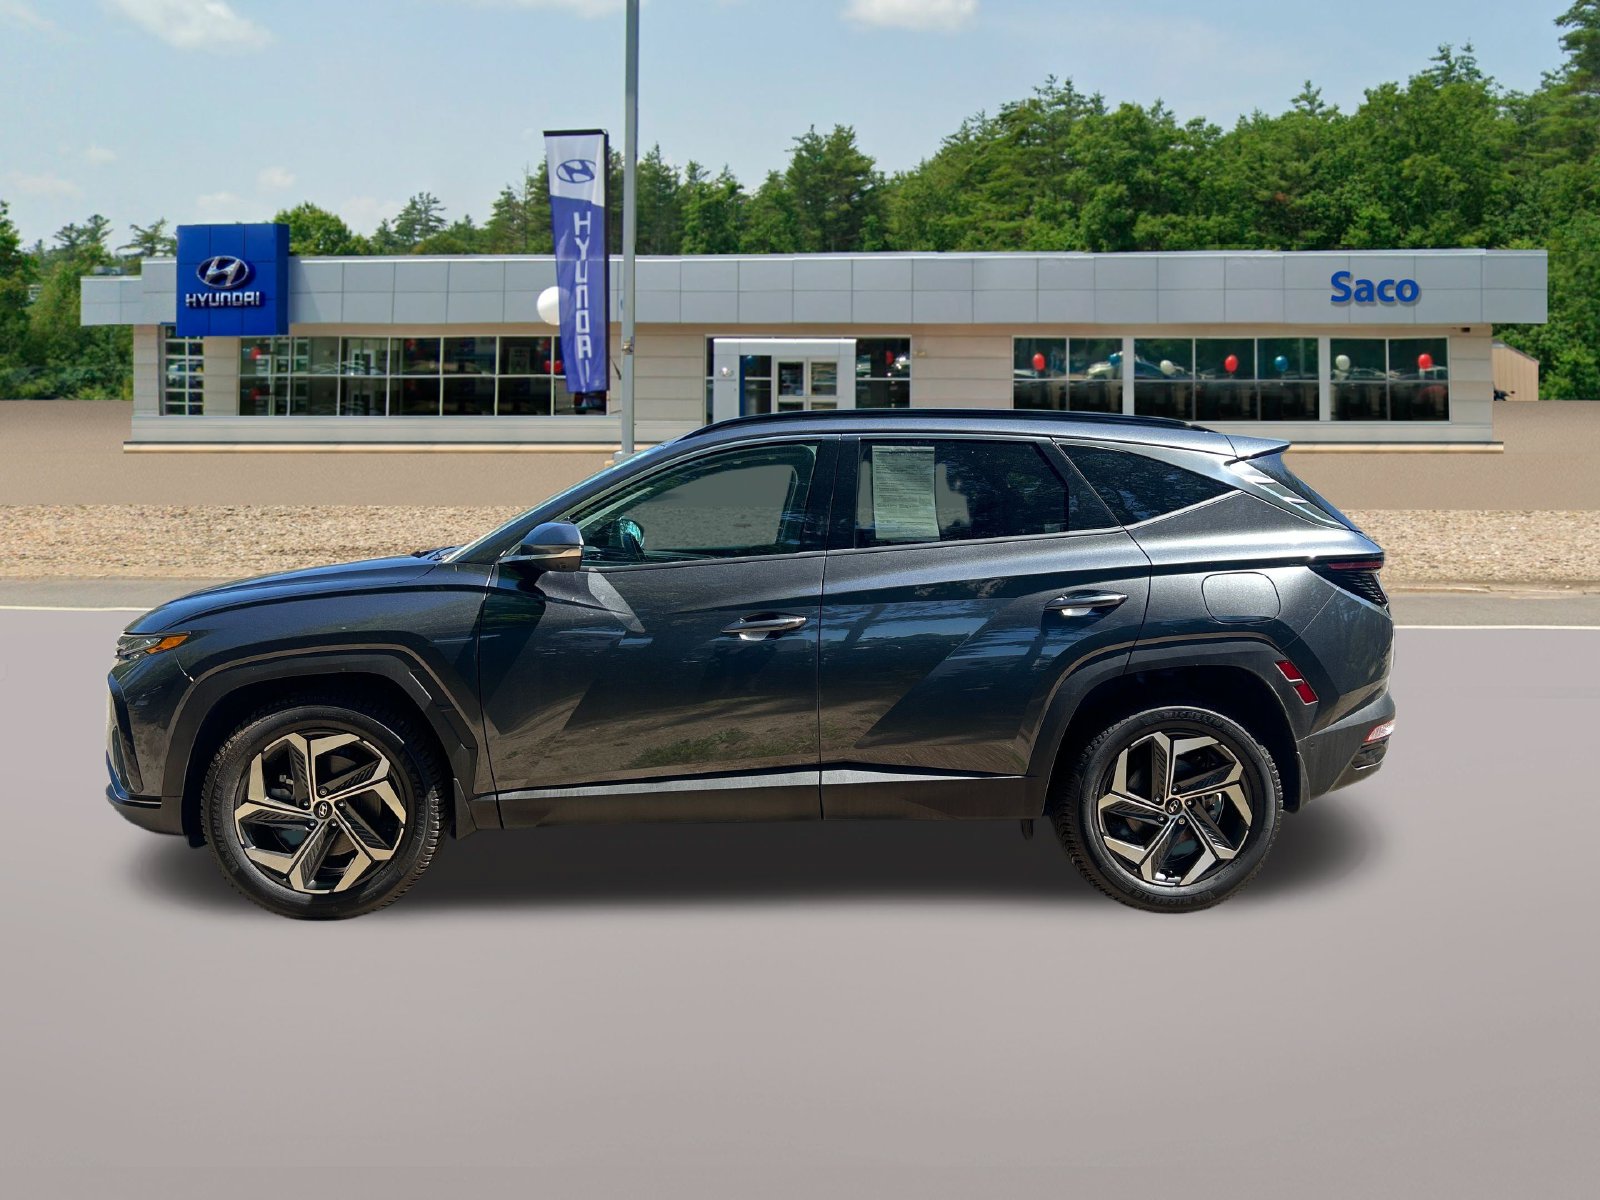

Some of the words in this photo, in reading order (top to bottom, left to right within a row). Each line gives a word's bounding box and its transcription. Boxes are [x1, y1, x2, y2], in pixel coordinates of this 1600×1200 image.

[185, 291, 260, 307] HYUNDAI
[573, 210, 592, 384] HYUNDAI
[1330, 270, 1420, 303] Saco
